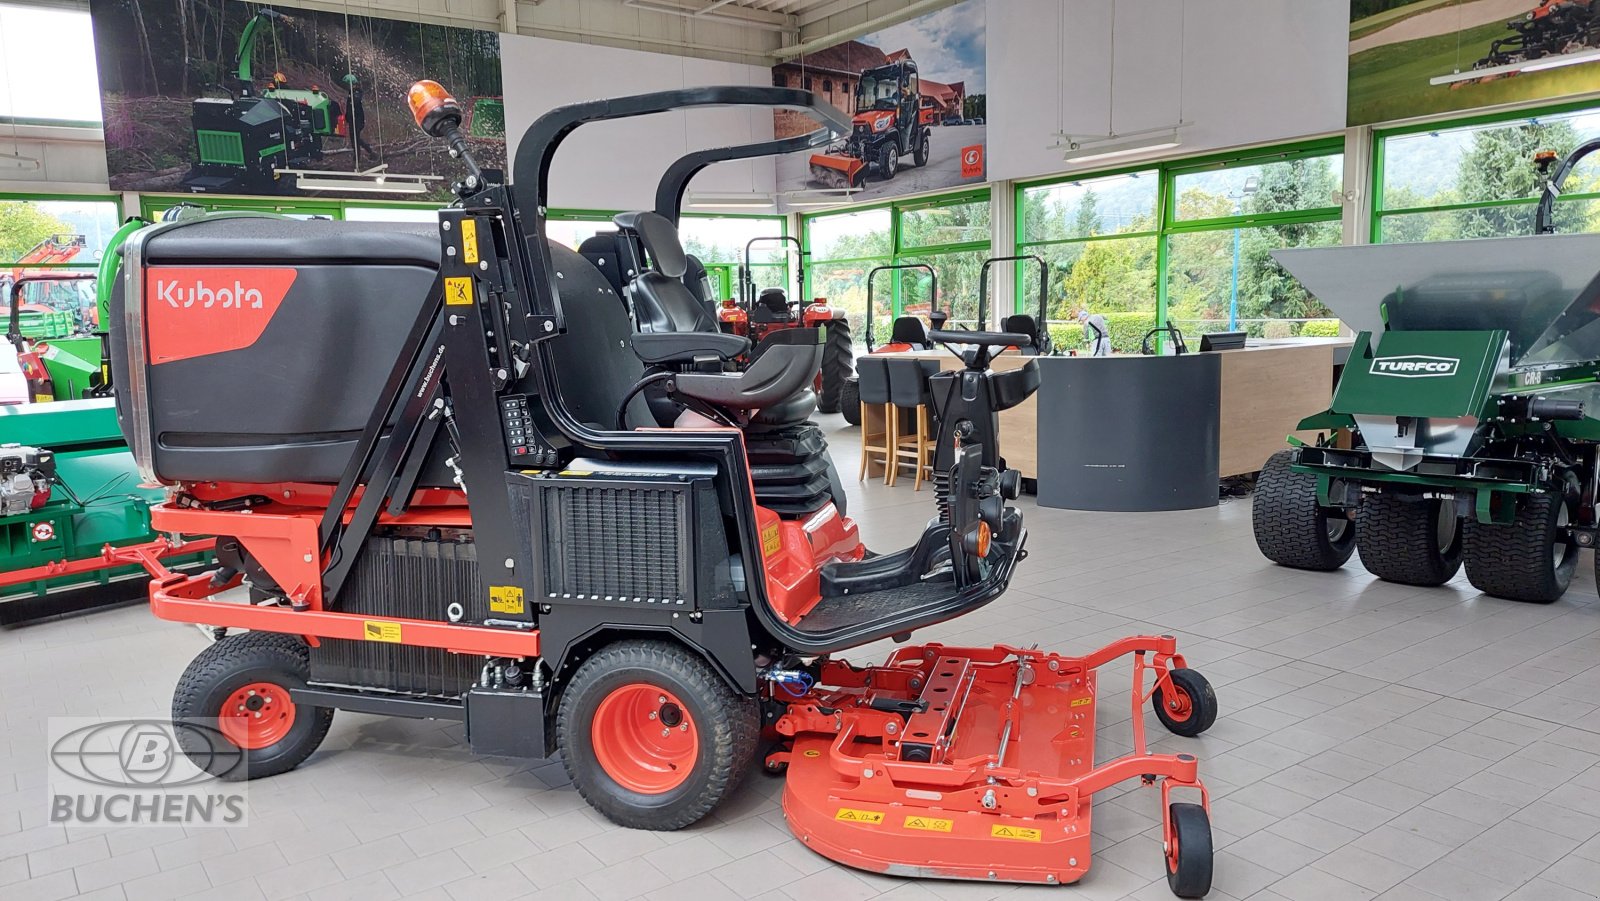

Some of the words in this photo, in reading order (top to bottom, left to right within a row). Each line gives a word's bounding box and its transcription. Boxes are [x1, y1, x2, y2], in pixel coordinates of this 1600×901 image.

[157, 280, 263, 308] Kubota
[416, 344, 446, 398] www.buchens.de
[1379, 361, 1451, 372] TURFCO
